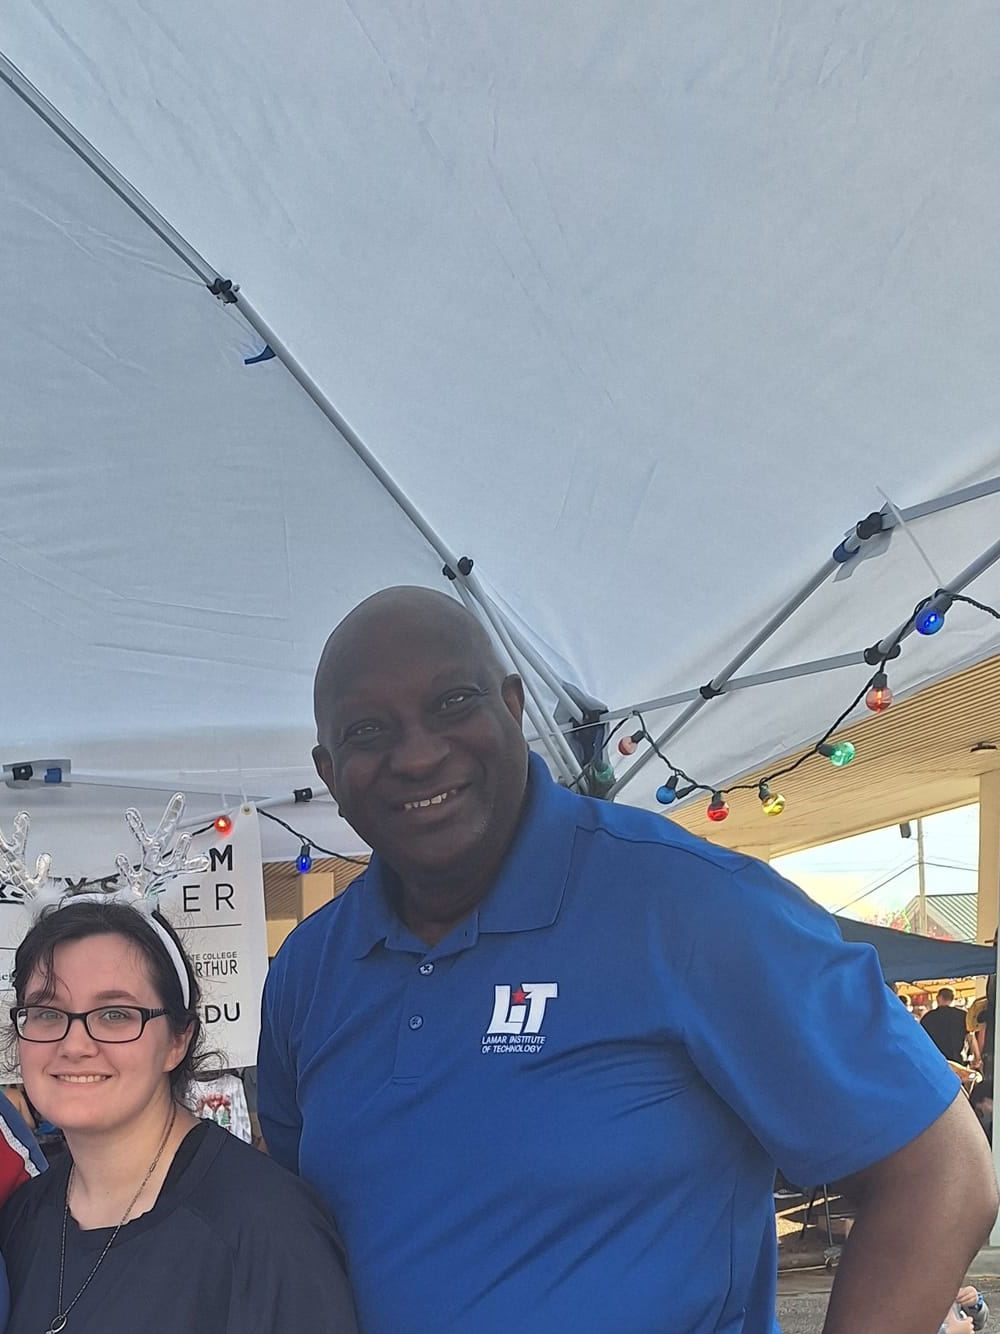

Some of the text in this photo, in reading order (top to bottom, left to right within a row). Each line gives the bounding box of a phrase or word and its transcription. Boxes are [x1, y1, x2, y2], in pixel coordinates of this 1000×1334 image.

[203, 951, 238, 960] COLLEGE
[196, 960, 238, 977] RTHUR
[482, 1035, 545, 1044] LAMAR INSTITUTE
[493, 1045, 542, 1053] TECHNOLOGY
